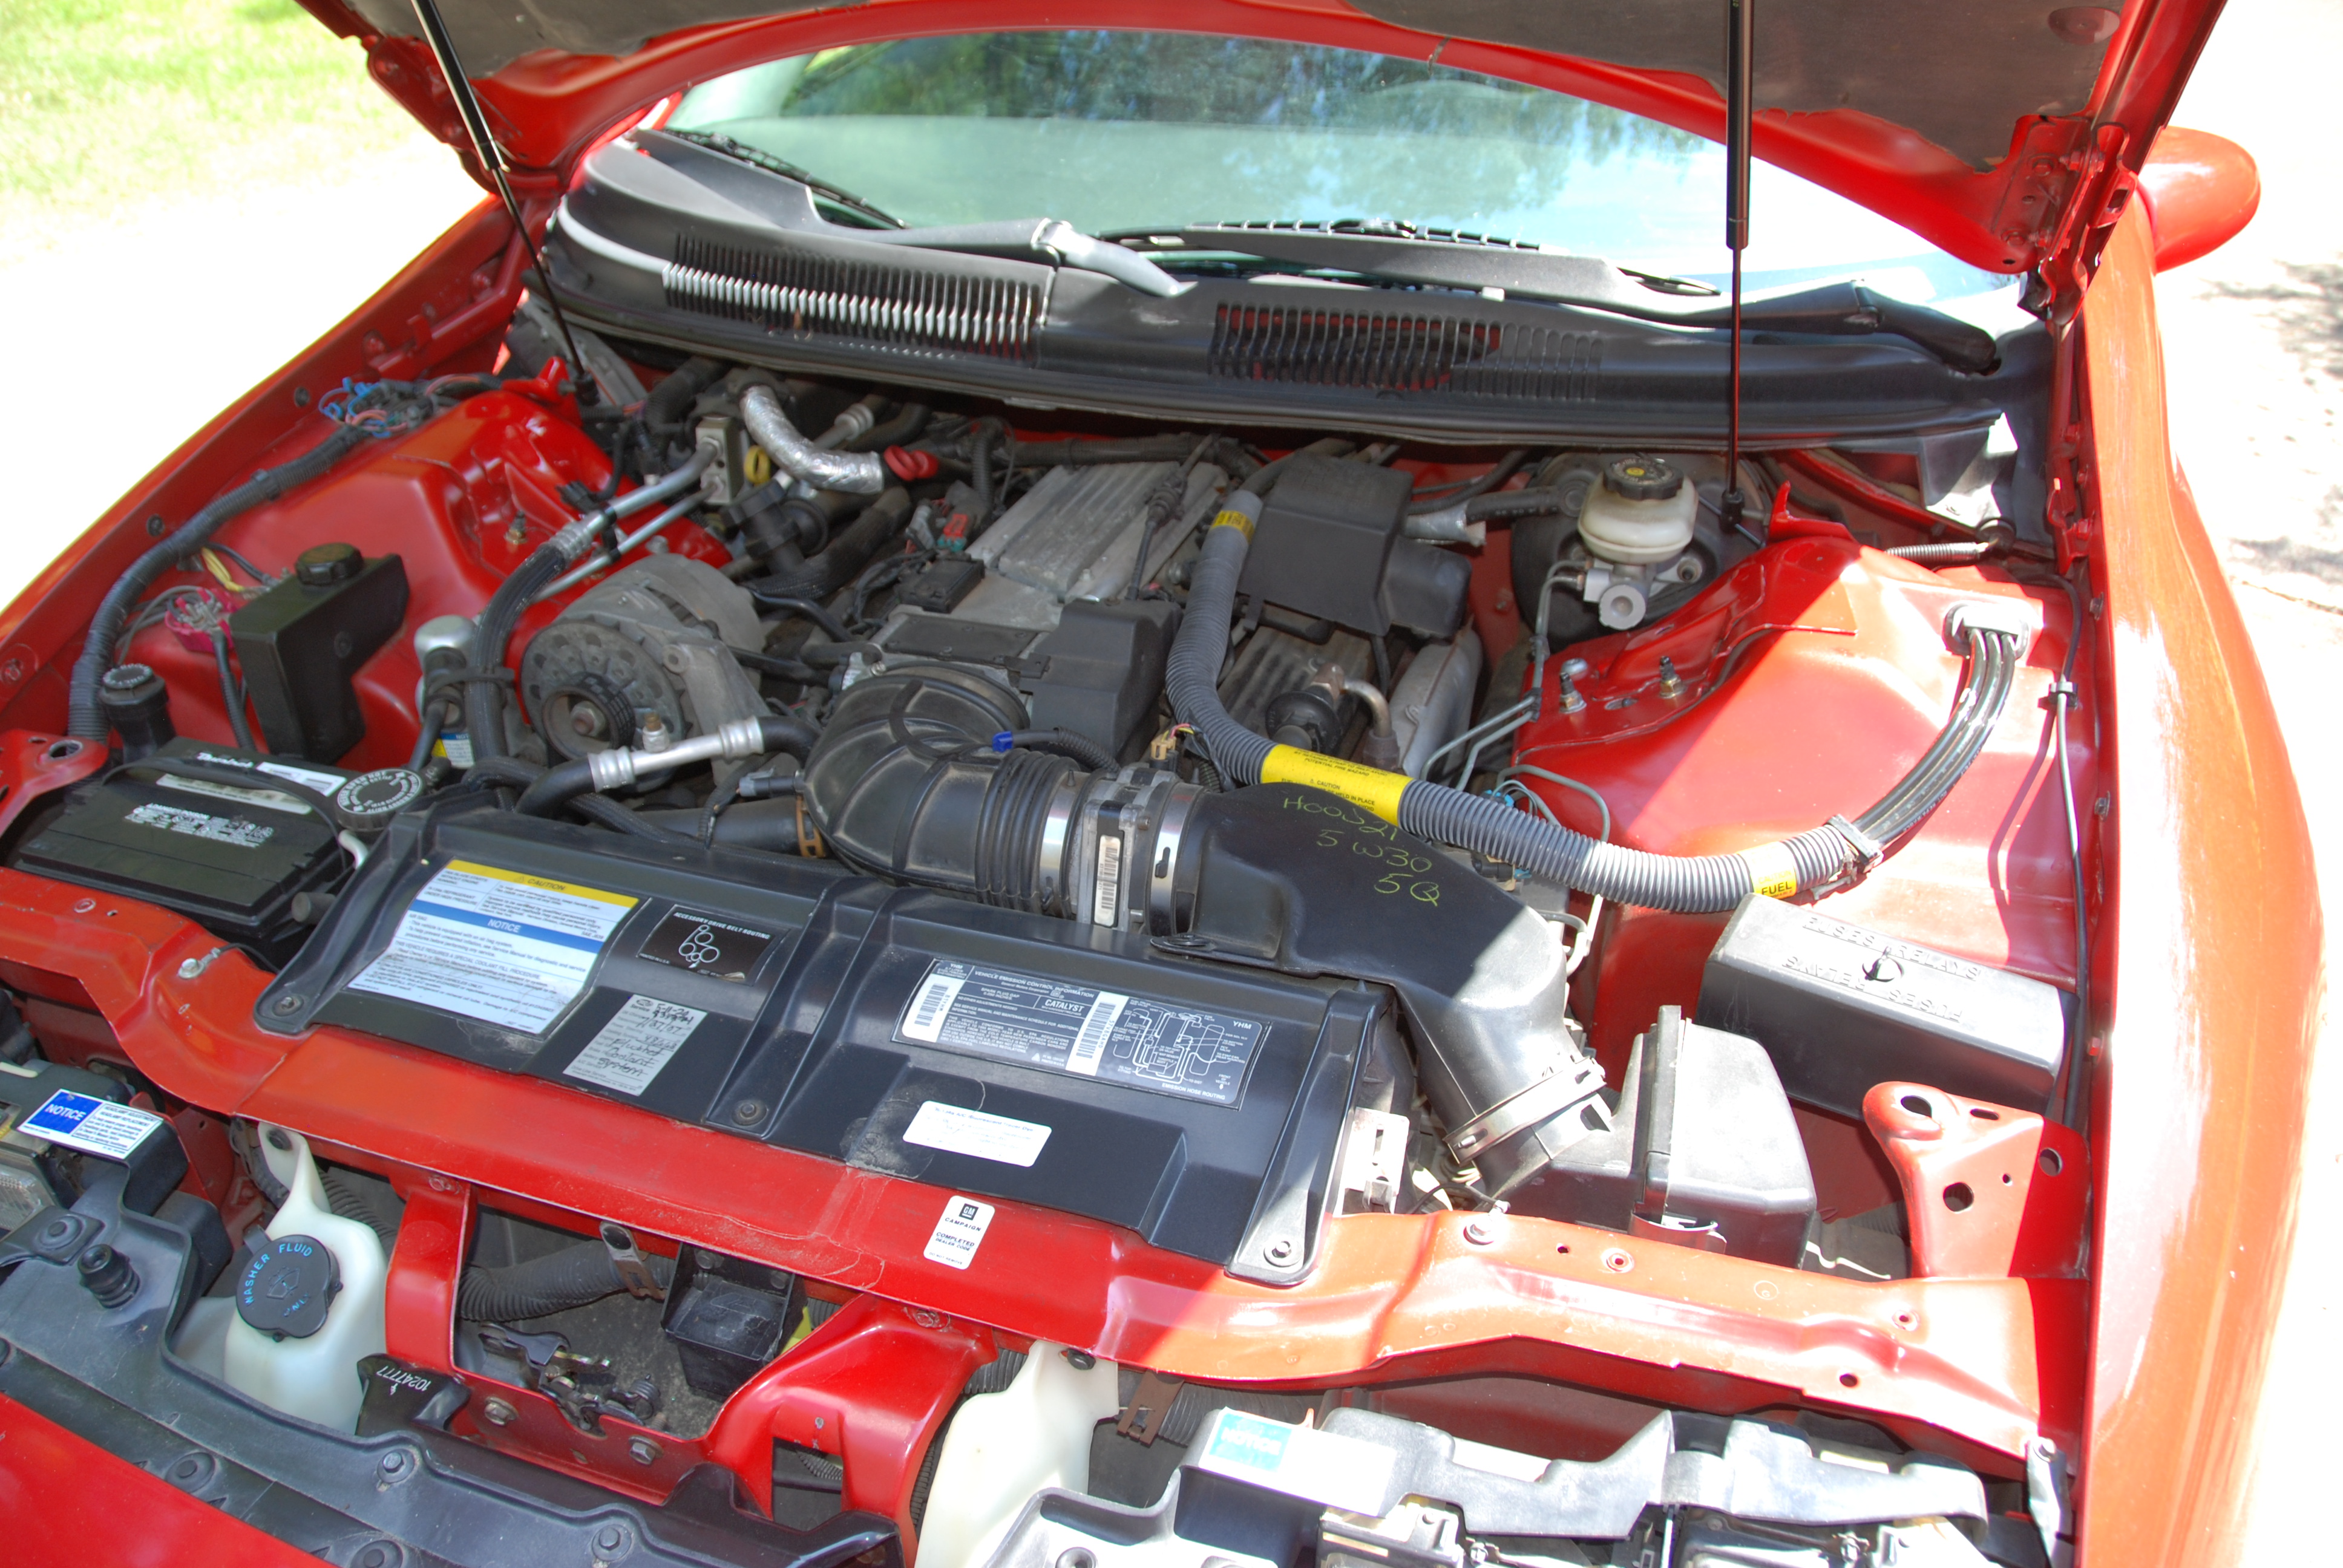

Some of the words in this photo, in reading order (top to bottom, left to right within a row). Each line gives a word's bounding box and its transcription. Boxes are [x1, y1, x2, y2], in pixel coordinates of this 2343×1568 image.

[1304, 757, 1333, 768] POTENTIAL
[1317, 780, 1341, 790] CAUTION
[1357, 796, 1375, 806] PLACE
[528, 878, 565, 890] CAUTION
[1758, 870, 1792, 884] CAUTION
[1761, 881, 1792, 895] FUEL
[488, 919, 520, 932] NOTICE
[673, 912, 708, 924] ACCESSORY
[707, 920, 727, 929] DRIVE
[742, 928, 771, 939] ROUTING
[1803, 916, 1875, 947] FUSES
[1895, 944, 1981, 981] RELAYS
[474, 959, 497, 969] COOLANT
[532, 956, 559, 966] diagnostic
[1782, 956, 1865, 991] RELAYS
[998, 975, 1026, 984] EMISSION
[1026, 981, 1054, 990] CONTROL
[1054, 986, 1094, 998] INFORMATION
[630, 1004, 650, 1012] Service
[1044, 999, 1084, 1012] CATALYST
[1889, 989, 1962, 1023] FUSES
[1233, 1021, 1252, 1029] YHM
[1161, 1082, 1187, 1091] EMISSION
[1201, 1091, 1225, 1099] ROUTING
[44, 1103, 87, 1121] NOTICE
[963, 1206, 975, 1217] GM
[945, 1217, 981, 1232] CAMPAIGN
[935, 1238, 955, 1246] DEALER
[936, 1232, 975, 1247] COMPLETED
[244, 1253, 270, 1304] WASHER
[279, 1243, 313, 1256] FLUID
[376, 1365, 431, 1391] 10247777
[1221, 1427, 1282, 1455] NOTICE
